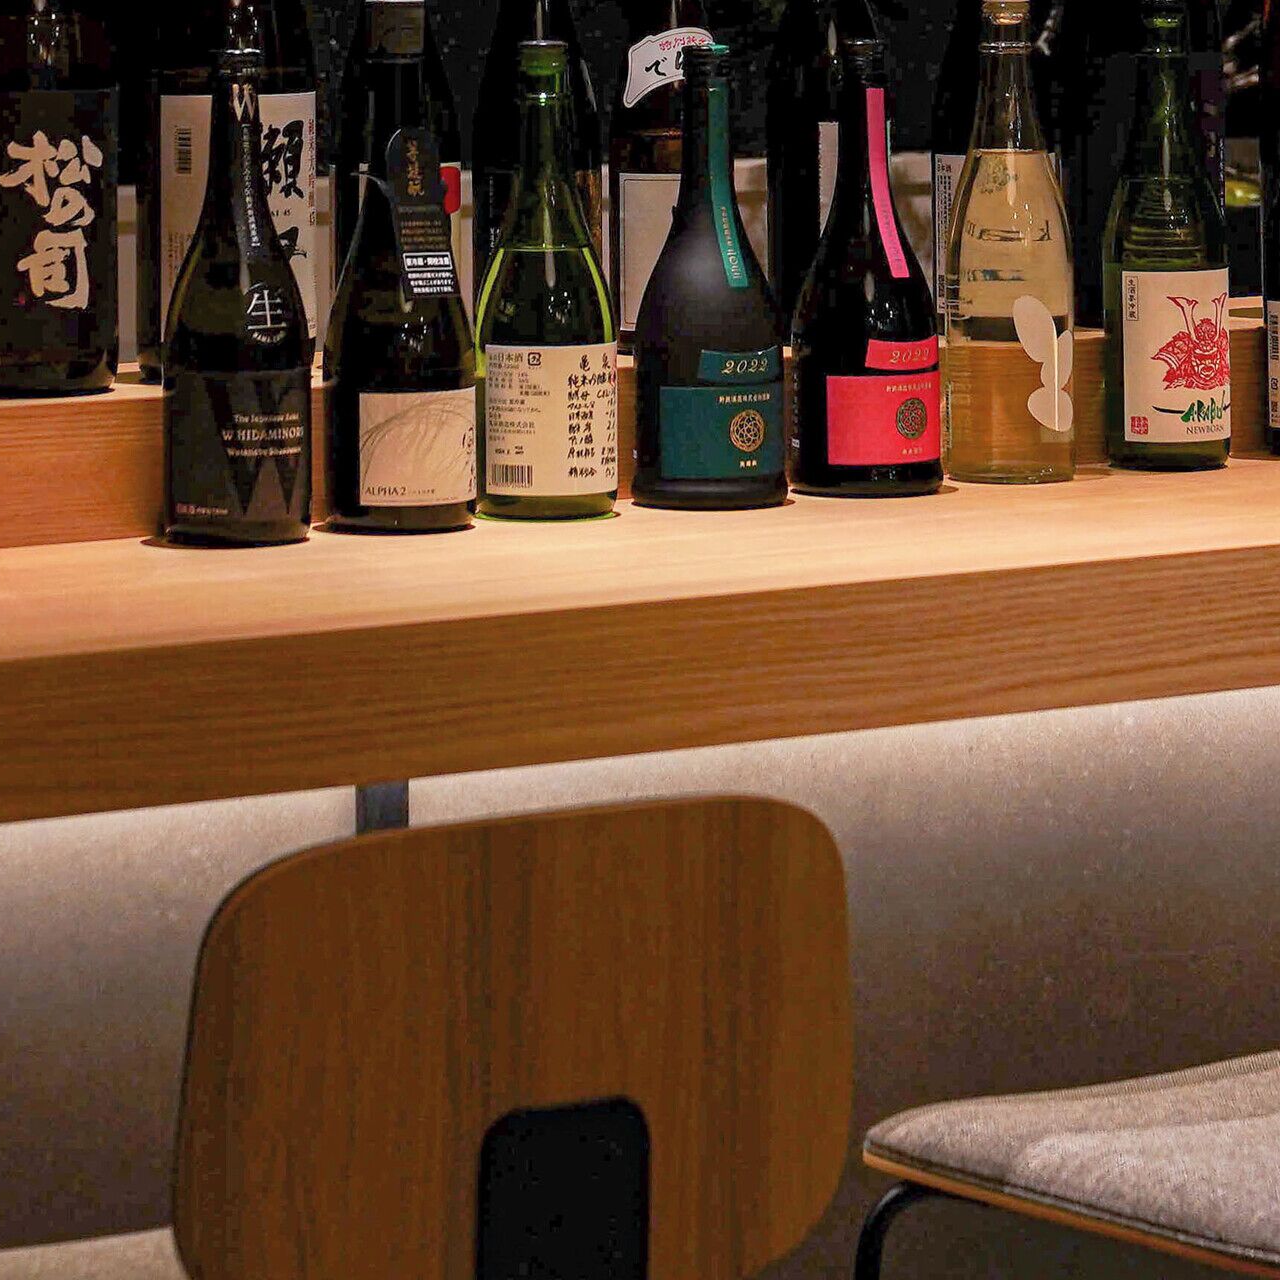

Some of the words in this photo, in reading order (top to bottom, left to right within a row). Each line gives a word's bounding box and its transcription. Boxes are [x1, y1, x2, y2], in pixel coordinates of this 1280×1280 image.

[232, 83, 256, 121] W
[247, 289, 287, 330] 生
[890, 348, 930, 363] 2022
[721, 358, 768, 374] 2022
[222, 429, 234, 441] W
[365, 486, 399, 496] ALPHA
[401, 486, 406, 495] 2
